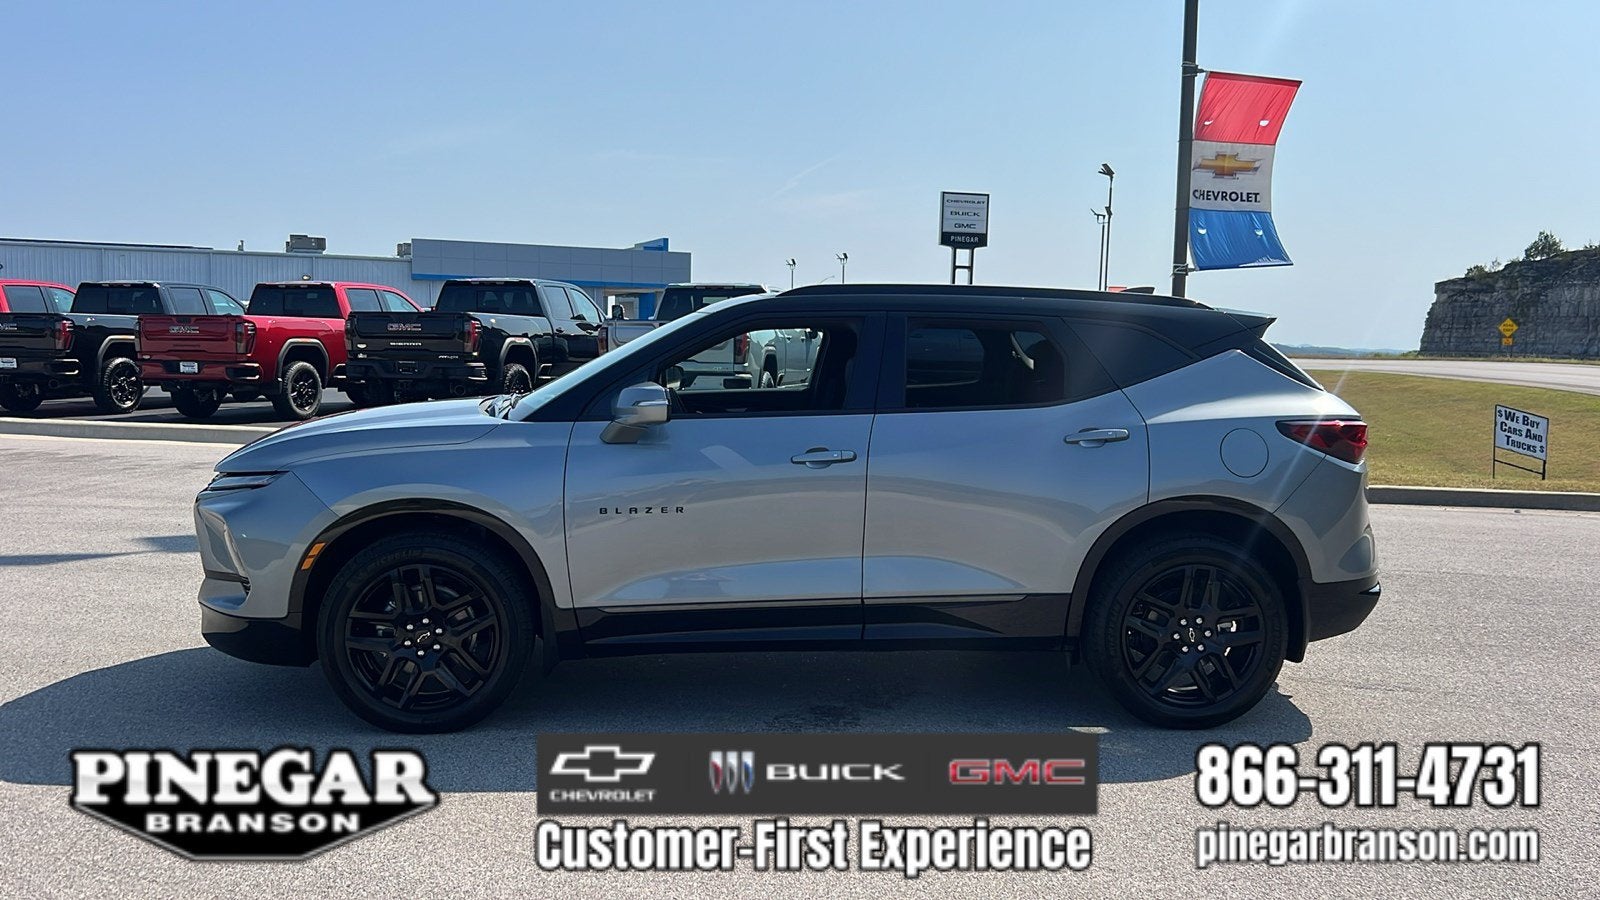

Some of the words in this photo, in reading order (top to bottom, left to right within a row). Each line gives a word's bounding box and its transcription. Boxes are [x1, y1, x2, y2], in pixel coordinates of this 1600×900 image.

[1192, 189, 1260, 203] CHEVROLET
[950, 235, 979, 243] PINEGAR
[168, 325, 200, 334] GMC
[387, 323, 422, 331] GMC
[1538, 445, 1545, 454] $
[599, 506, 684, 515] BLAZER
